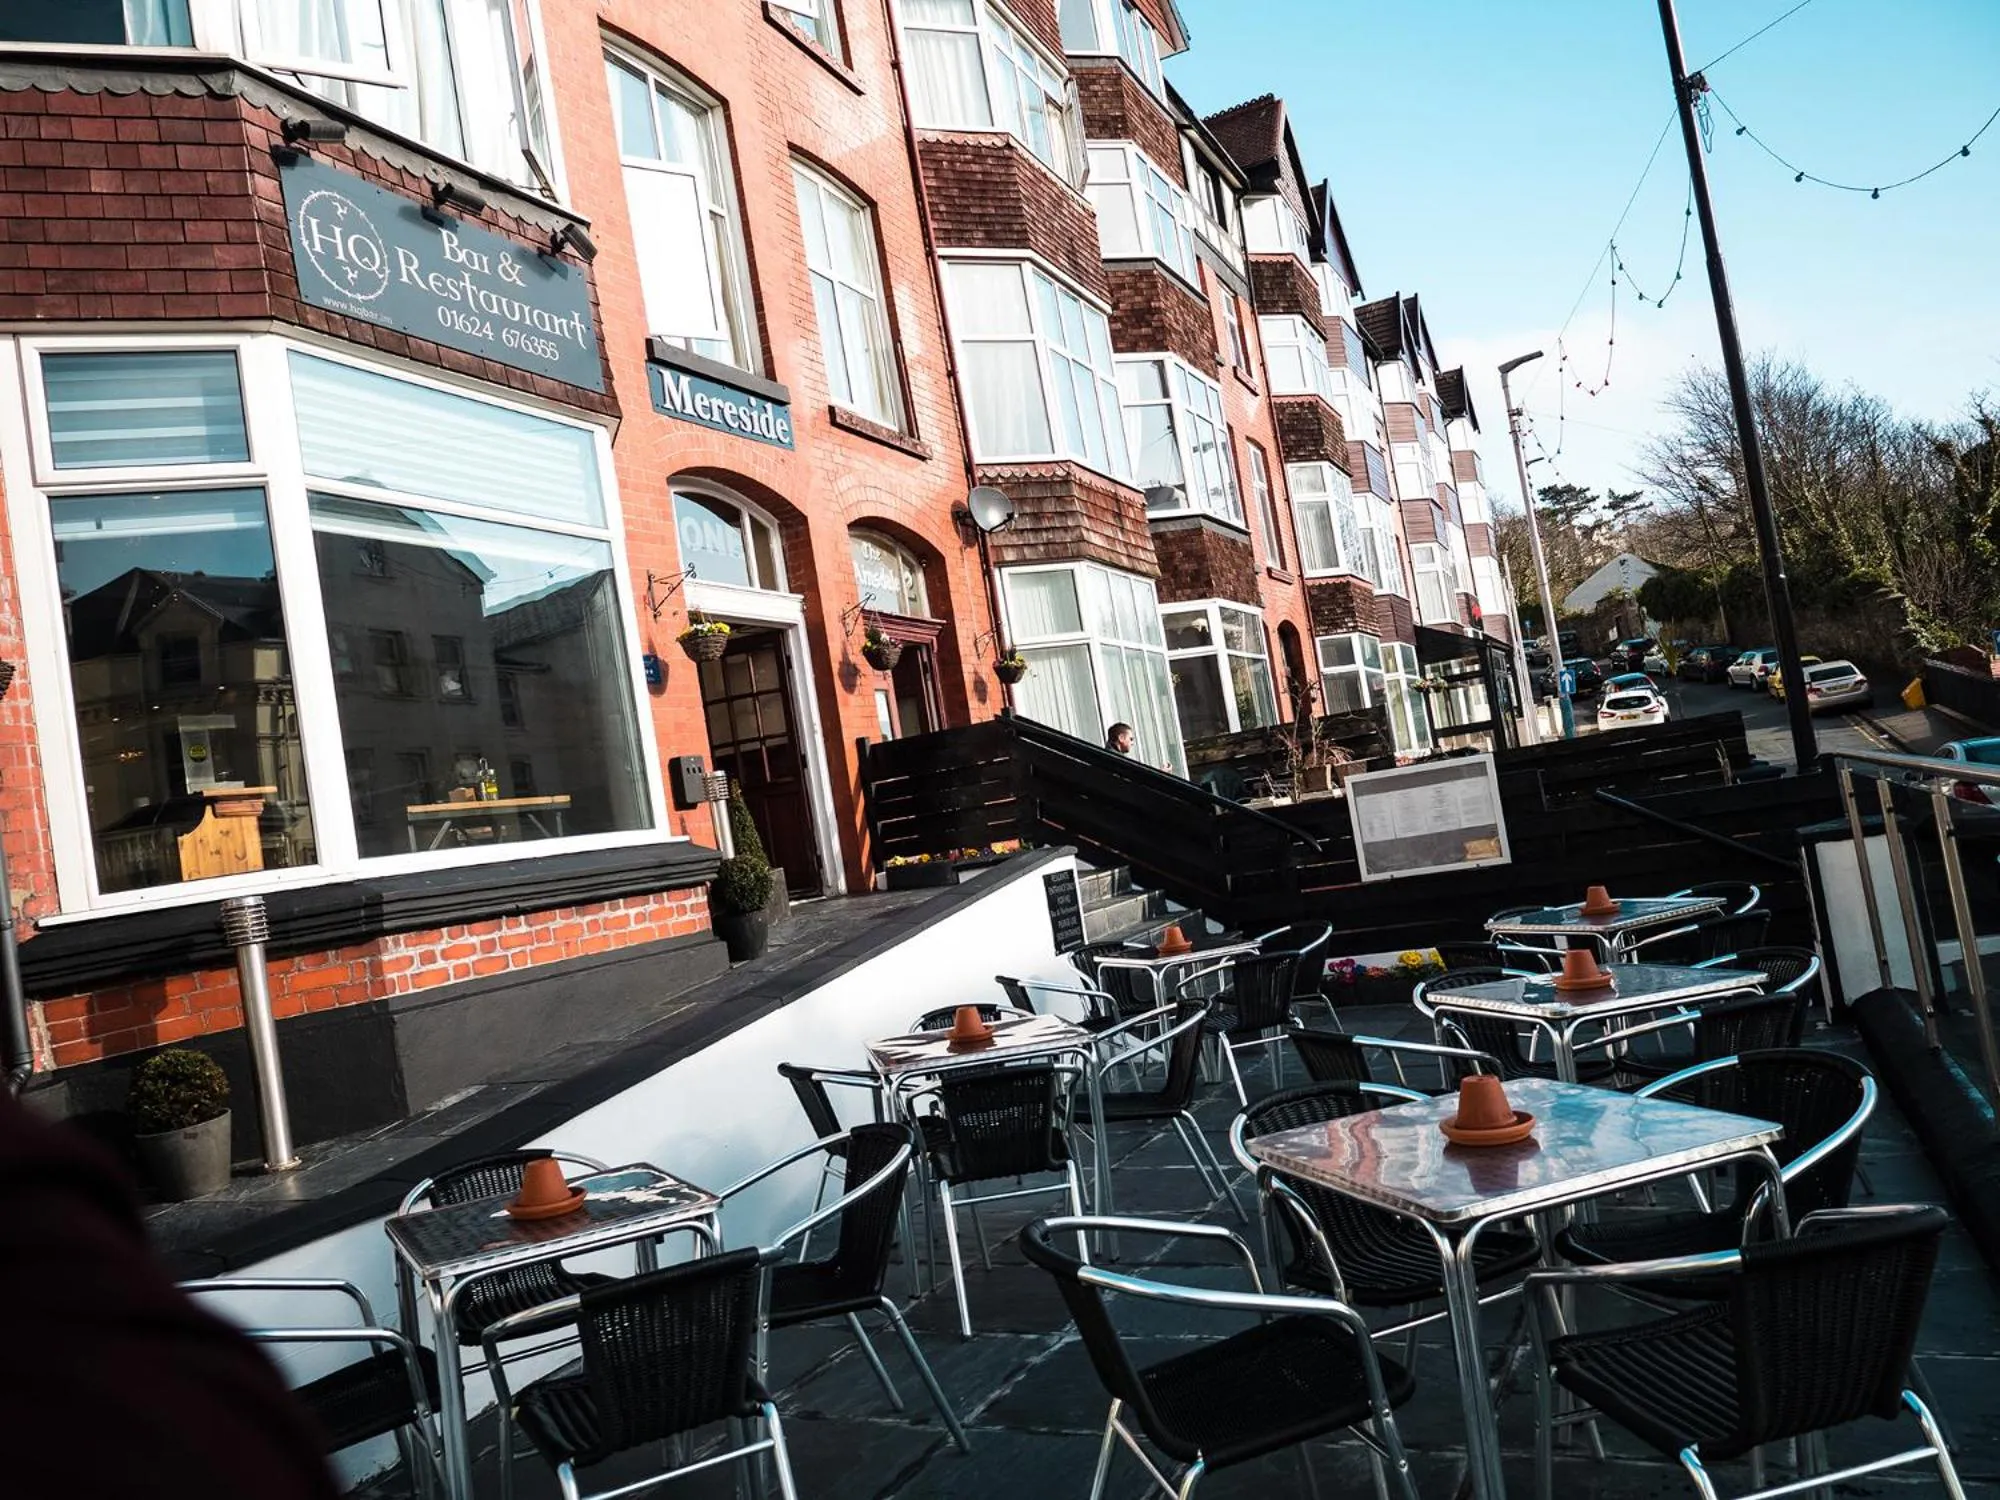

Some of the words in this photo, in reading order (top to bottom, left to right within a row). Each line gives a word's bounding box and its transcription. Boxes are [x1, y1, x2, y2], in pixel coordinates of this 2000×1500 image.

[310, 217, 386, 277] HQ
[439, 228, 491, 275] Bar
[498, 251, 527, 288] &
[396, 247, 587, 350] Restaurant
[438, 307, 494, 340] 01624
[502, 330, 560, 361] 676355
[657, 368, 790, 443] Mereside
